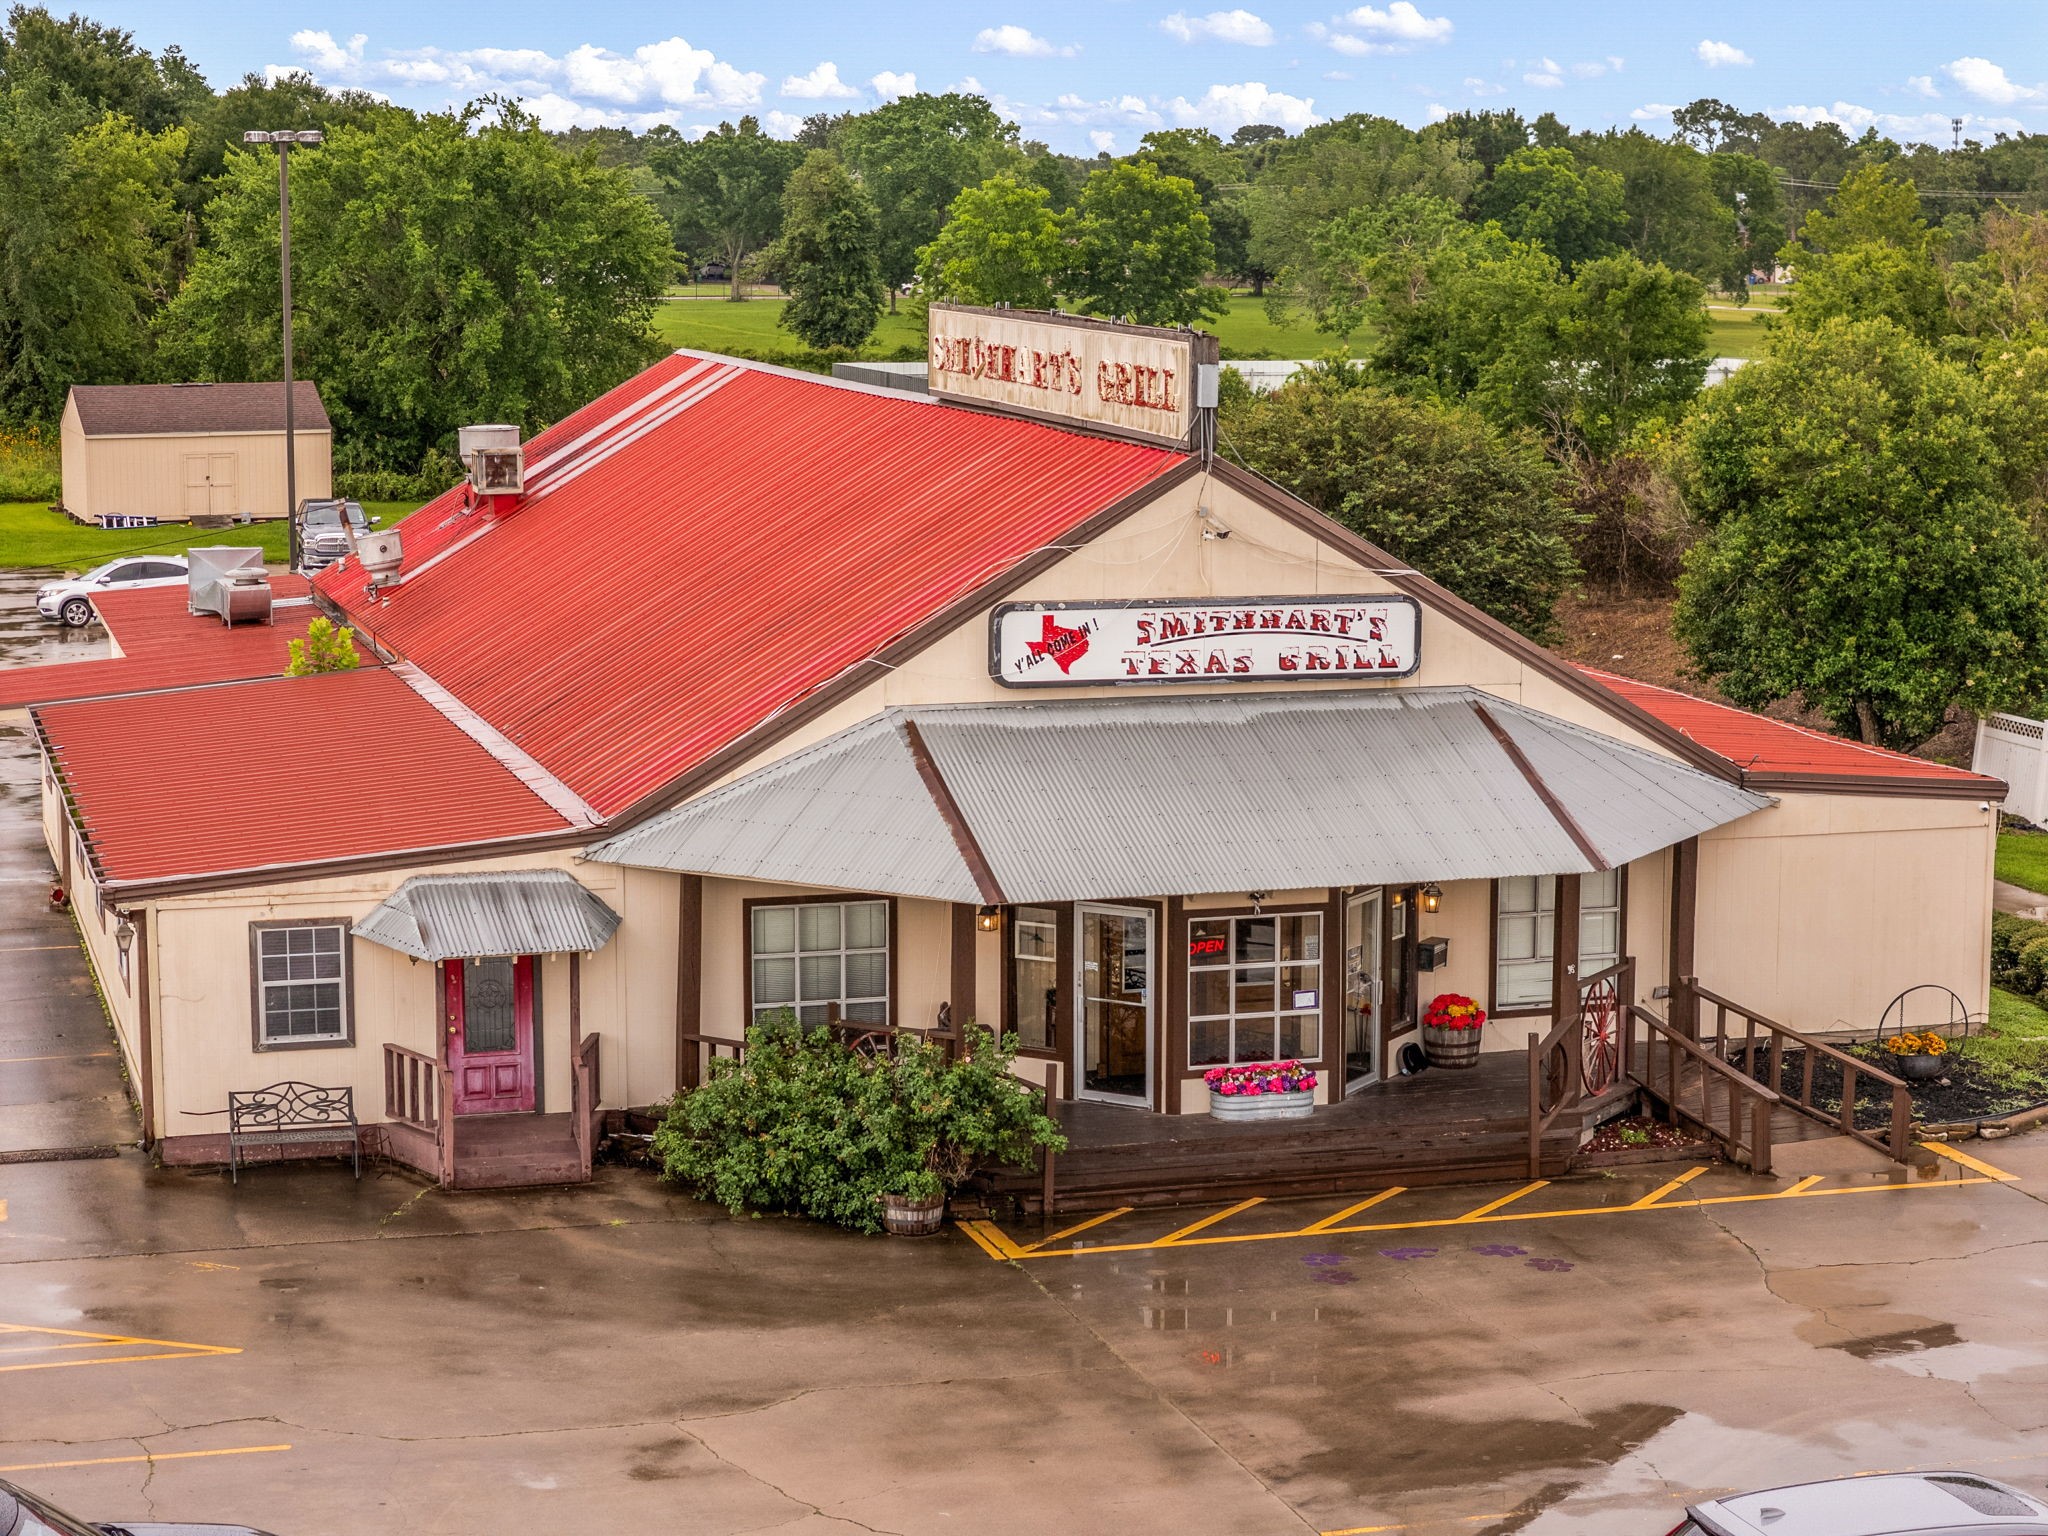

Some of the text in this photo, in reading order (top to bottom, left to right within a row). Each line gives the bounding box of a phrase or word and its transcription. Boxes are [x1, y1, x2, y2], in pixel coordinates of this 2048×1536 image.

[1097, 359, 1179, 412] GRILL
[1137, 609, 1388, 646] SMITHHART'S
[1015, 649, 1045, 674] Y'ALL
[1047, 631, 1077, 656] COME
[1121, 644, 1400, 675] TEXAS GRILL
[1190, 939, 1225, 955] OPEN
